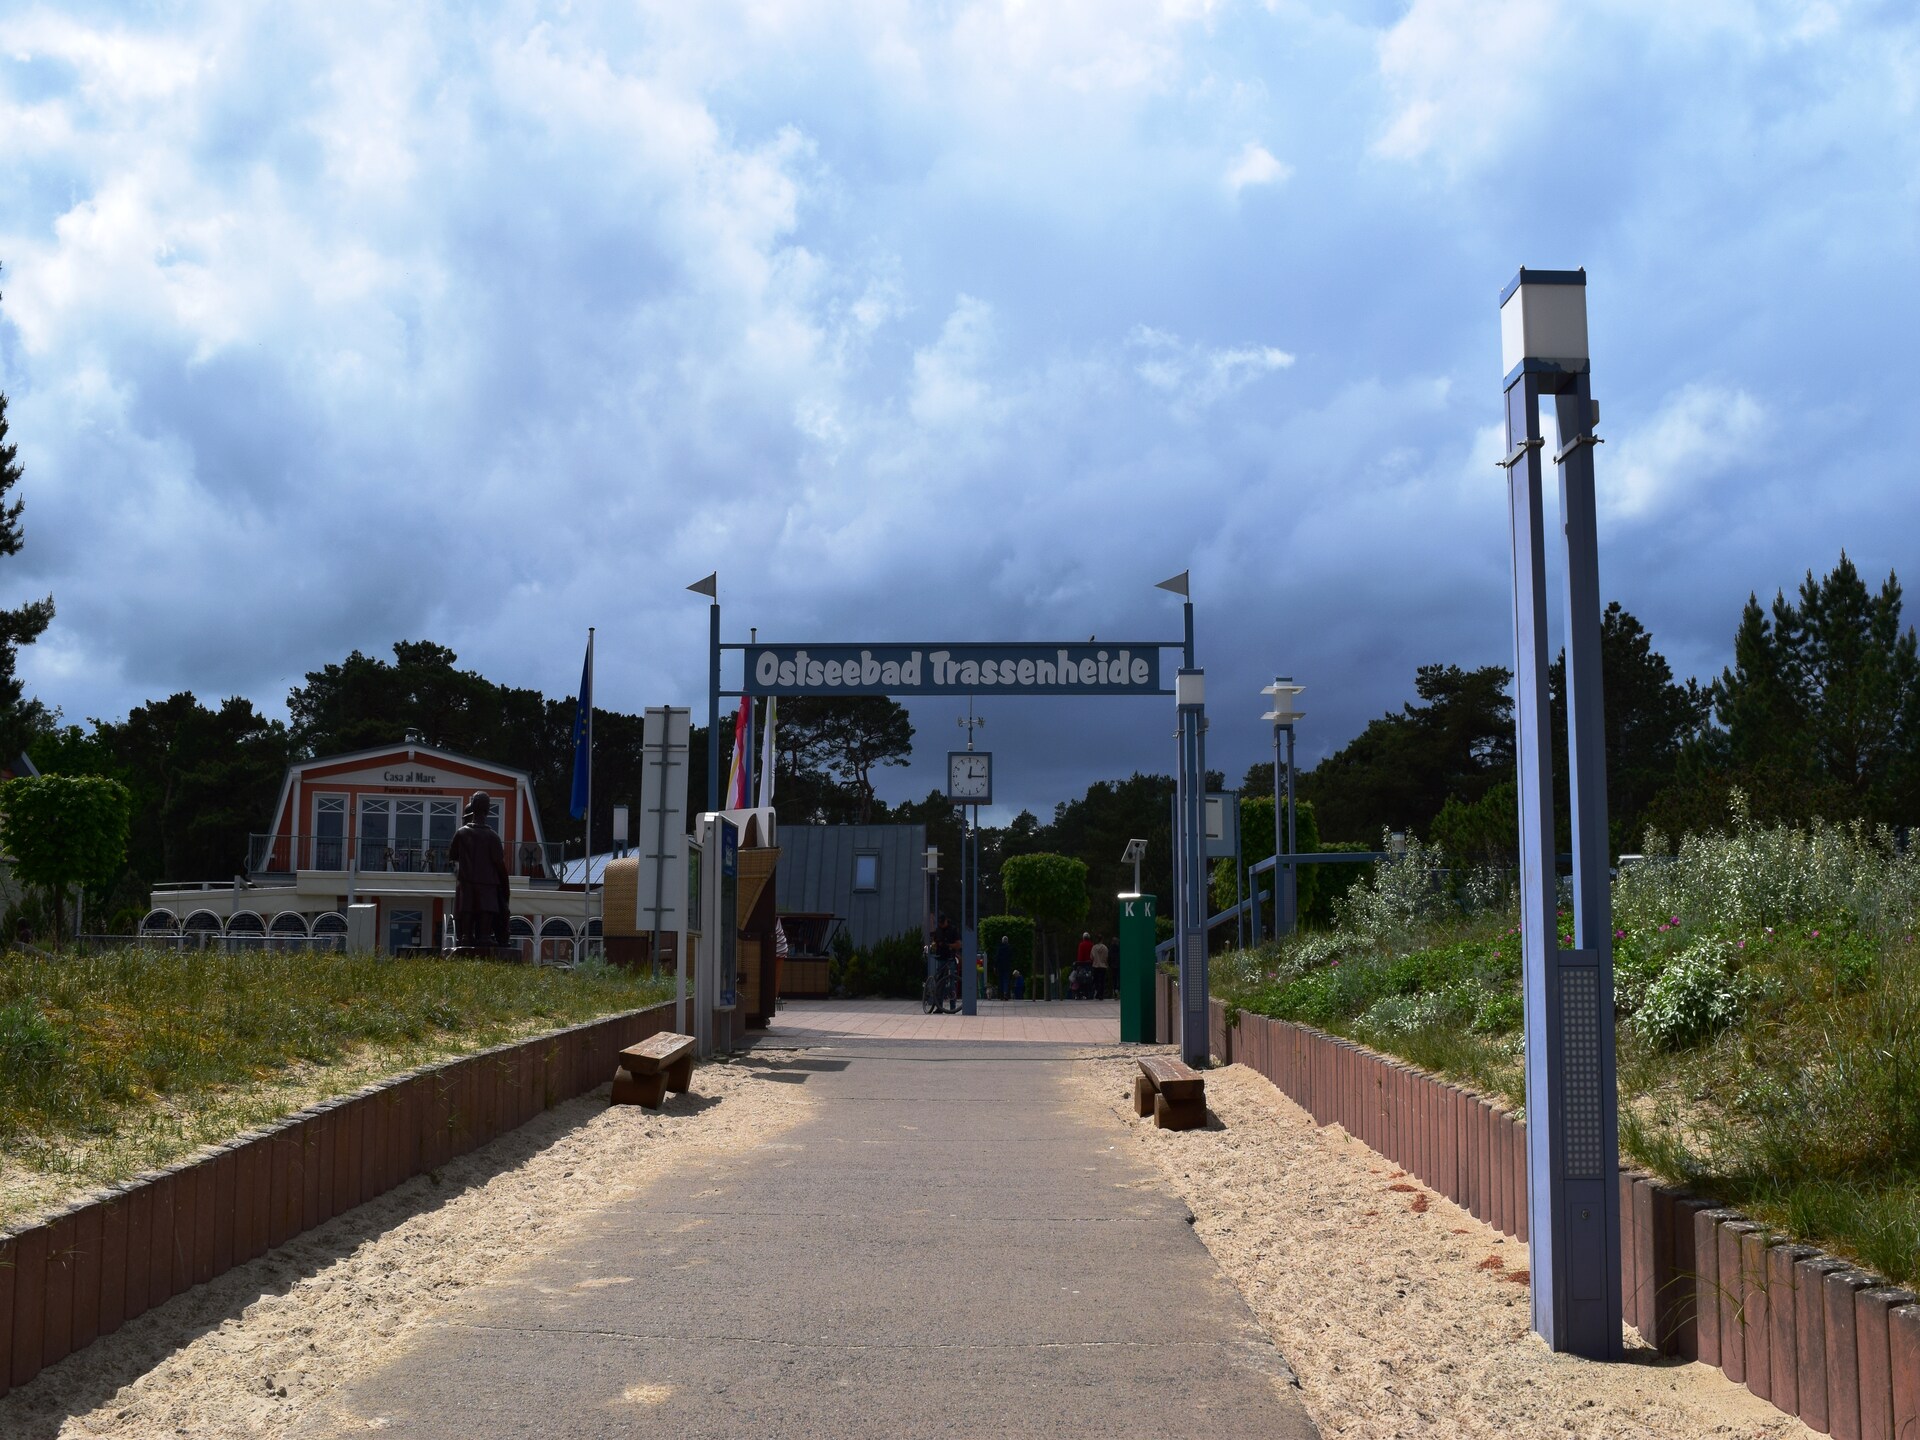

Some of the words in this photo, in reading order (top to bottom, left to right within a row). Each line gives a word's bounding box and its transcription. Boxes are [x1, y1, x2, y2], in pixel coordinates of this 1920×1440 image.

[755, 650, 922, 687] Ostseebad
[929, 649, 1149, 686] Trassenheide
[384, 771, 404, 782] Casa
[405, 772, 414, 782] al
[415, 772, 436, 783] Mare
[1125, 901, 1135, 917] K
[1144, 901, 1152, 917] K
